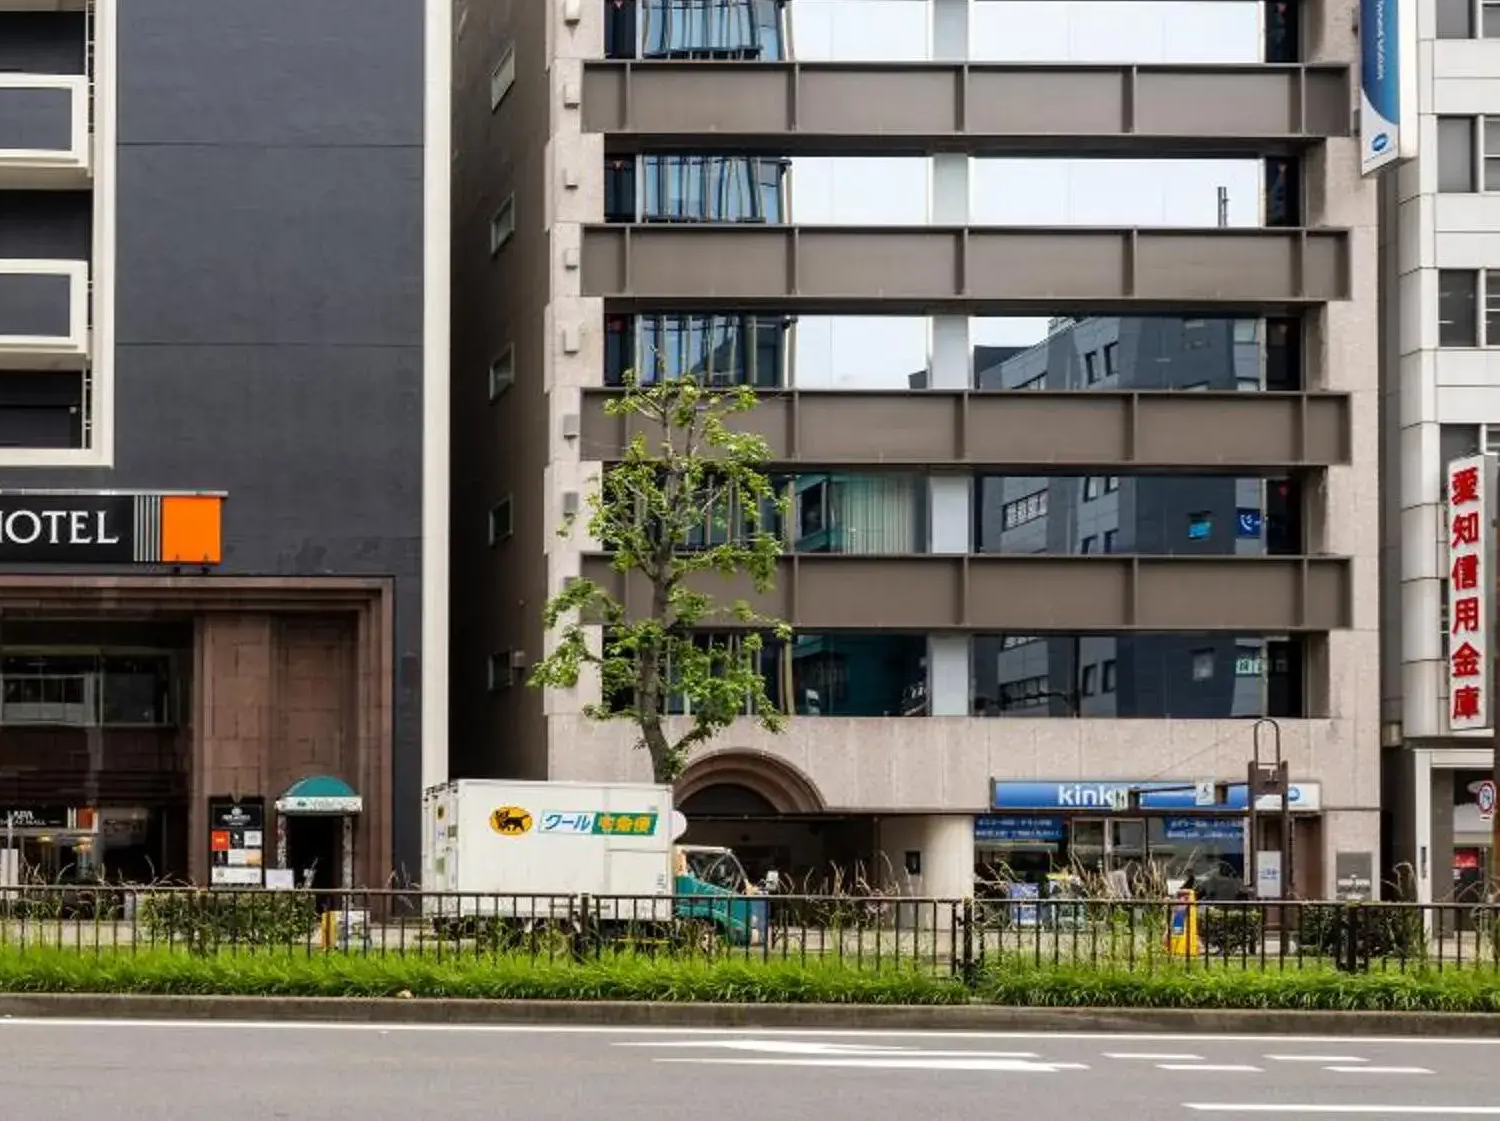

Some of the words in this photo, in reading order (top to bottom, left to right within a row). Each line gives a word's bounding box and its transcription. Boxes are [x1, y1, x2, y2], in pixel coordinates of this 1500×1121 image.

[1451, 466, 1479, 721] 愛知信用金庫
